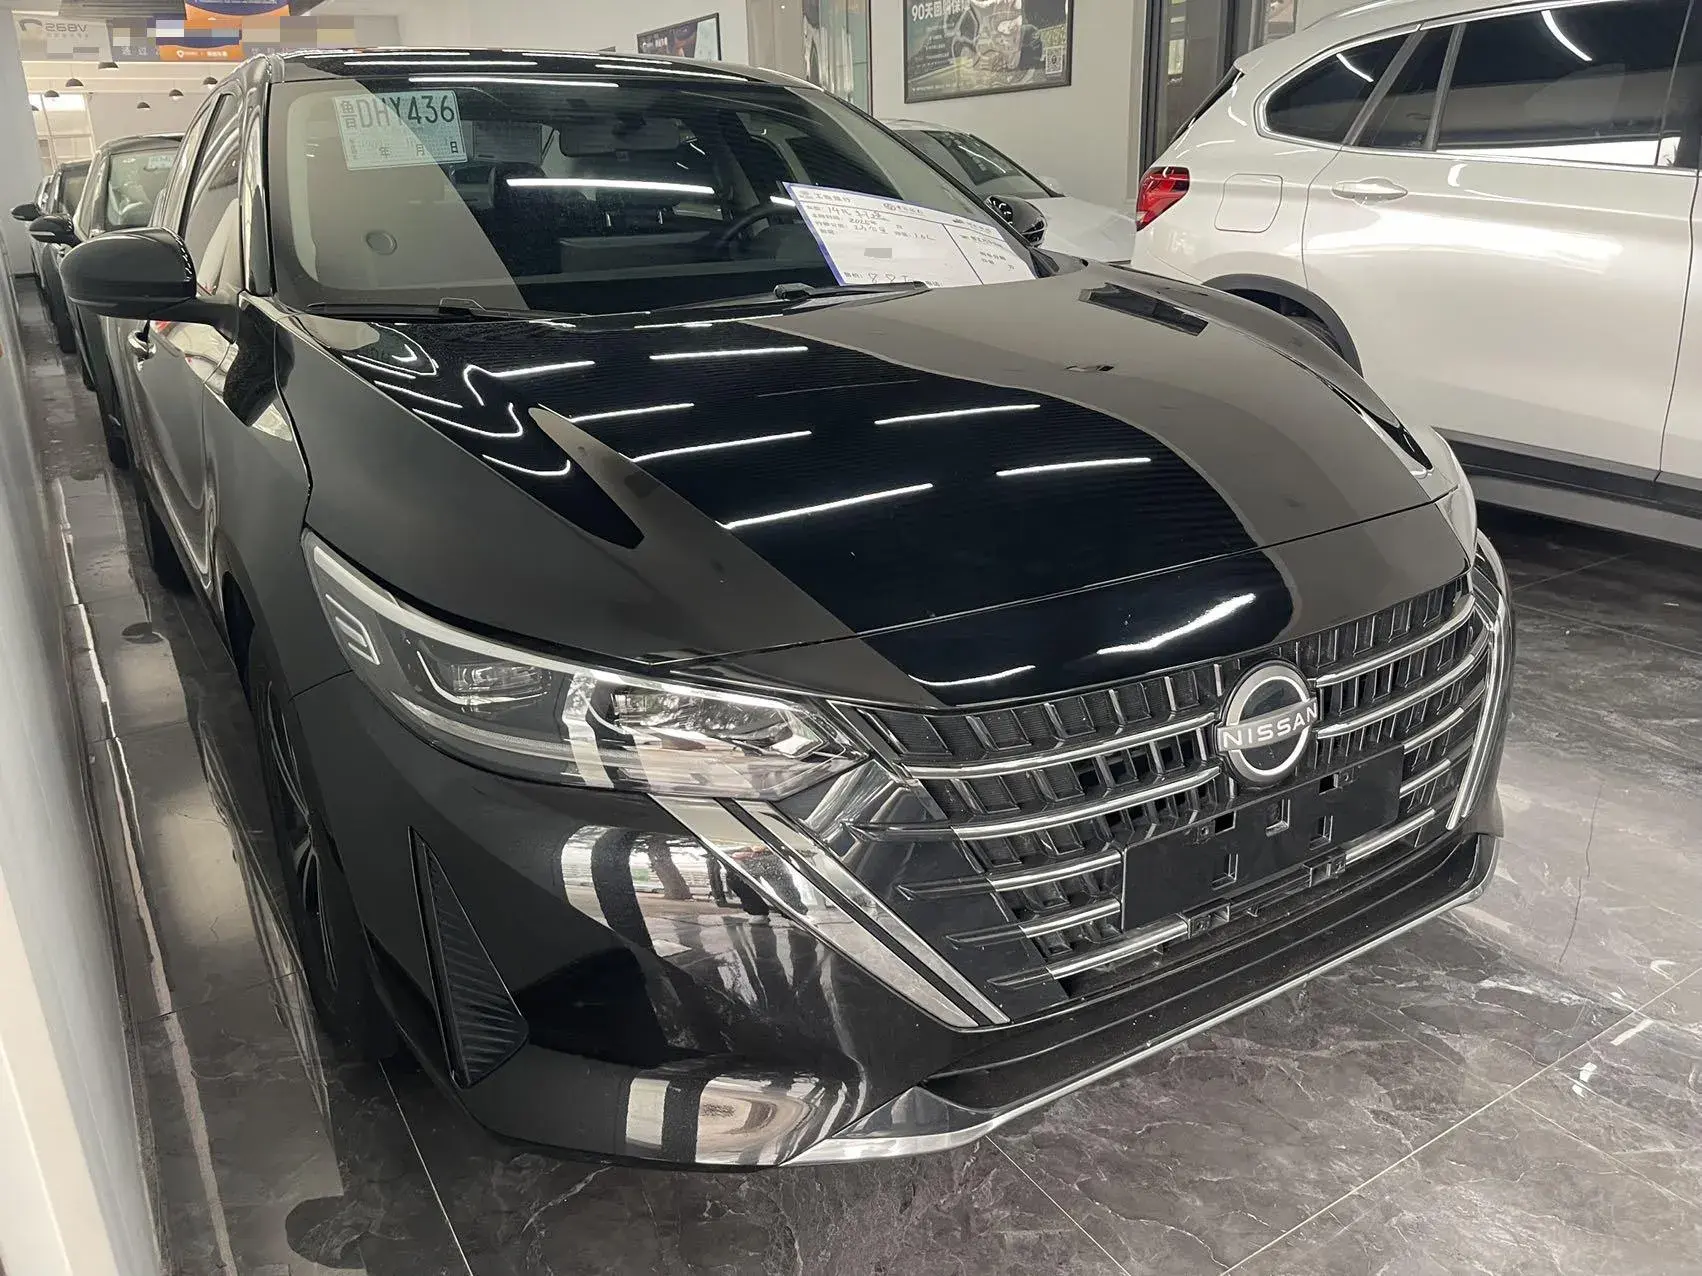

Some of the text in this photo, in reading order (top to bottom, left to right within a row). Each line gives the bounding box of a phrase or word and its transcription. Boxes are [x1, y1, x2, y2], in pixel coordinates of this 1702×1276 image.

[416, 144, 426, 156] 月
[450, 141, 459, 154] 日
[1222, 702, 1318, 748] NISSAN
